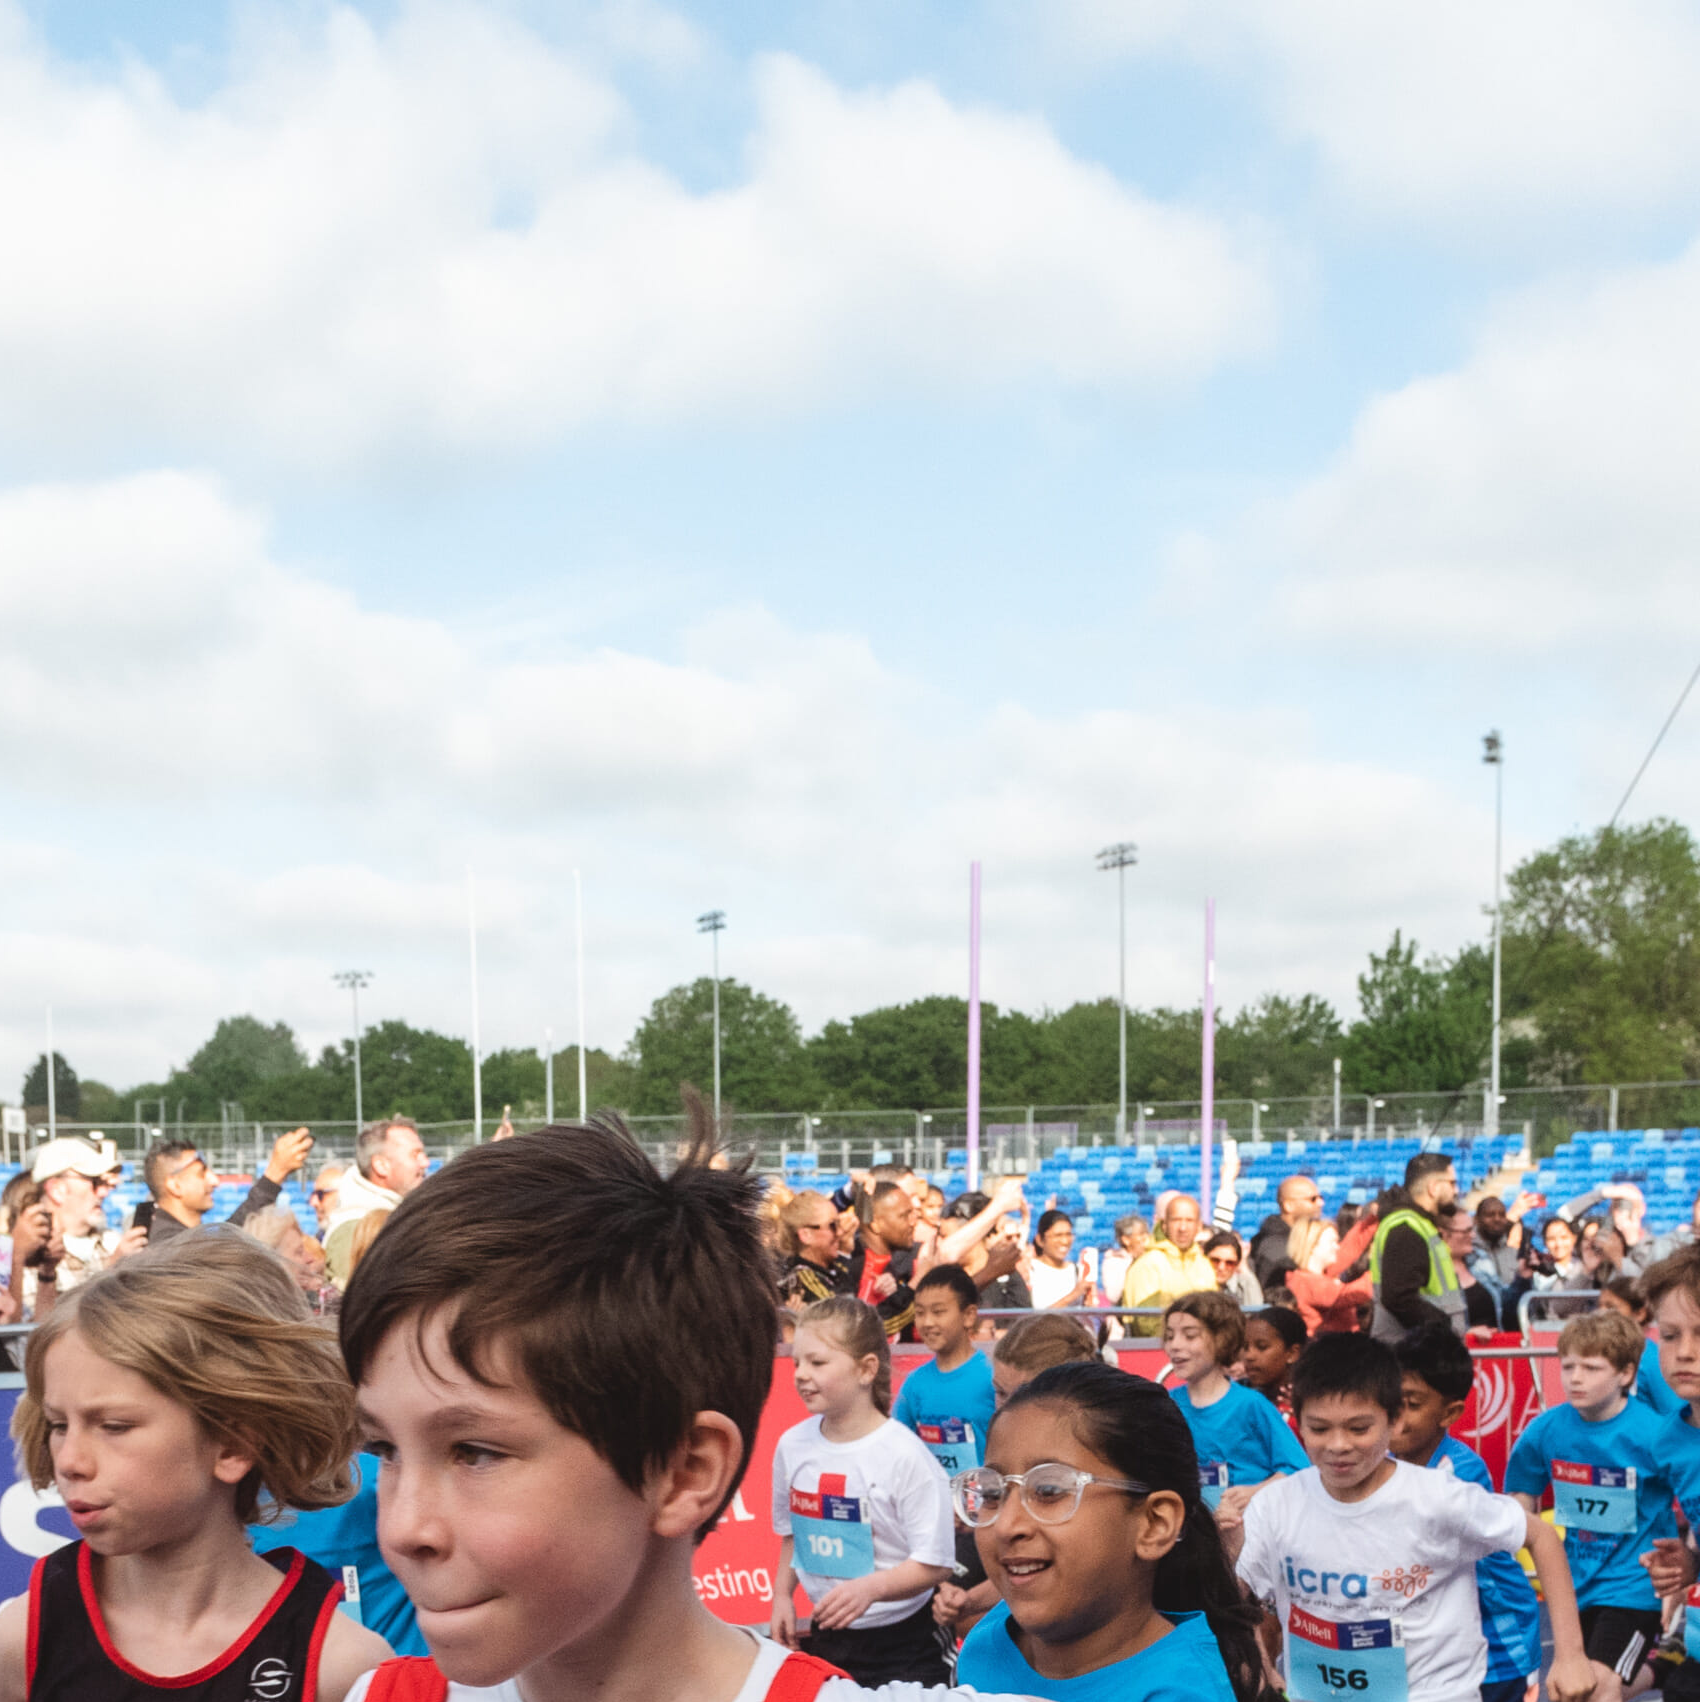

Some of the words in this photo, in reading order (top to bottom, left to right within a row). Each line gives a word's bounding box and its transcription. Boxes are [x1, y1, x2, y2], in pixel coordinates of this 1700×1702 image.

[1575, 1497, 1610, 1517] 177
[808, 1534, 844, 1559] 101
[1279, 1556, 1369, 1600] icra
[1316, 1663, 1369, 1690] 156
